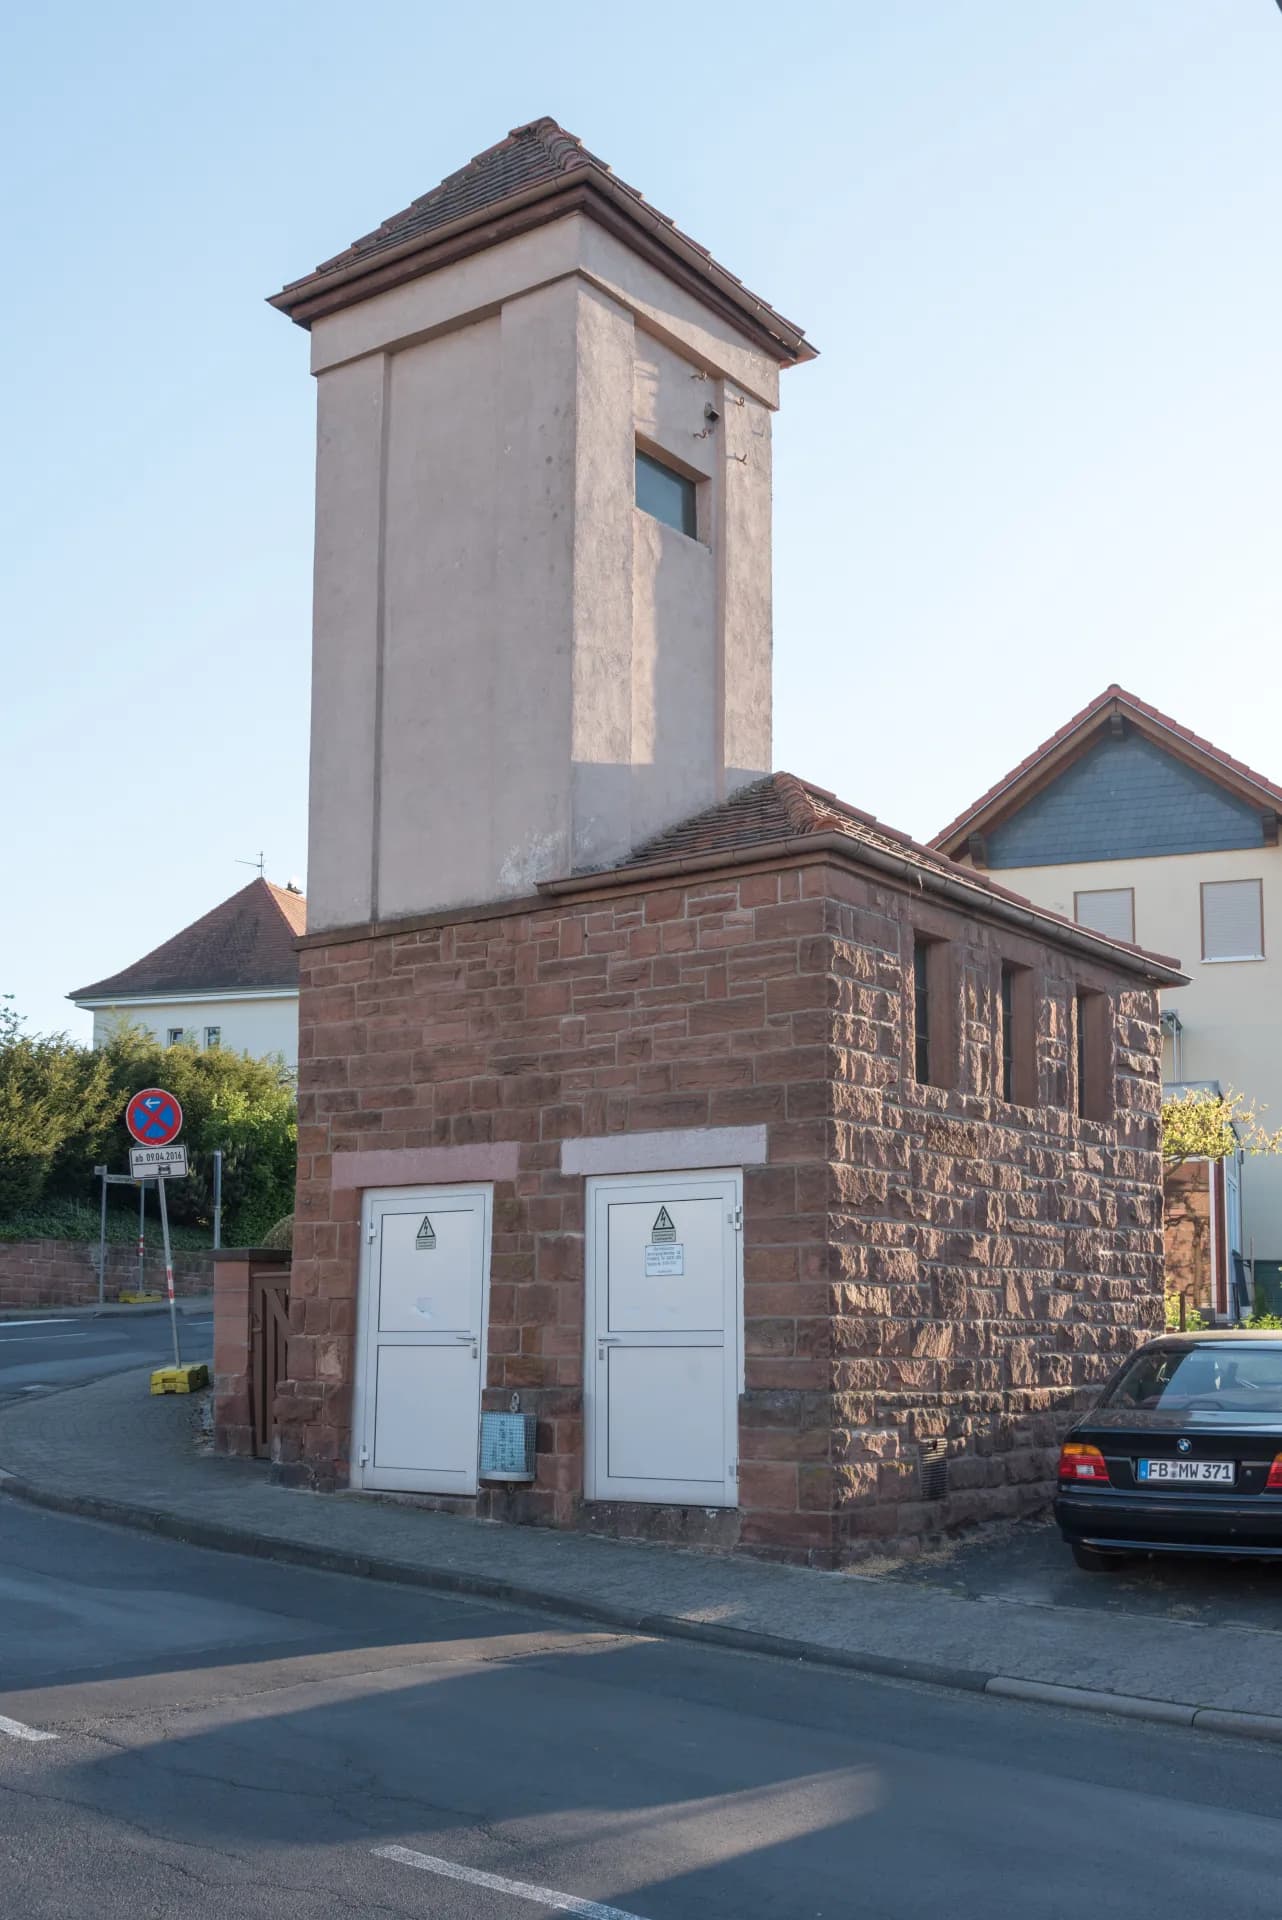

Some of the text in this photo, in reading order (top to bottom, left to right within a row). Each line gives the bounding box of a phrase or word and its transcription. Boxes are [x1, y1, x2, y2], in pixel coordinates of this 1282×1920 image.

[135, 1152, 182, 1162] ab 09.04.2016
[1149, 1463, 1231, 1479] FB MW 371
